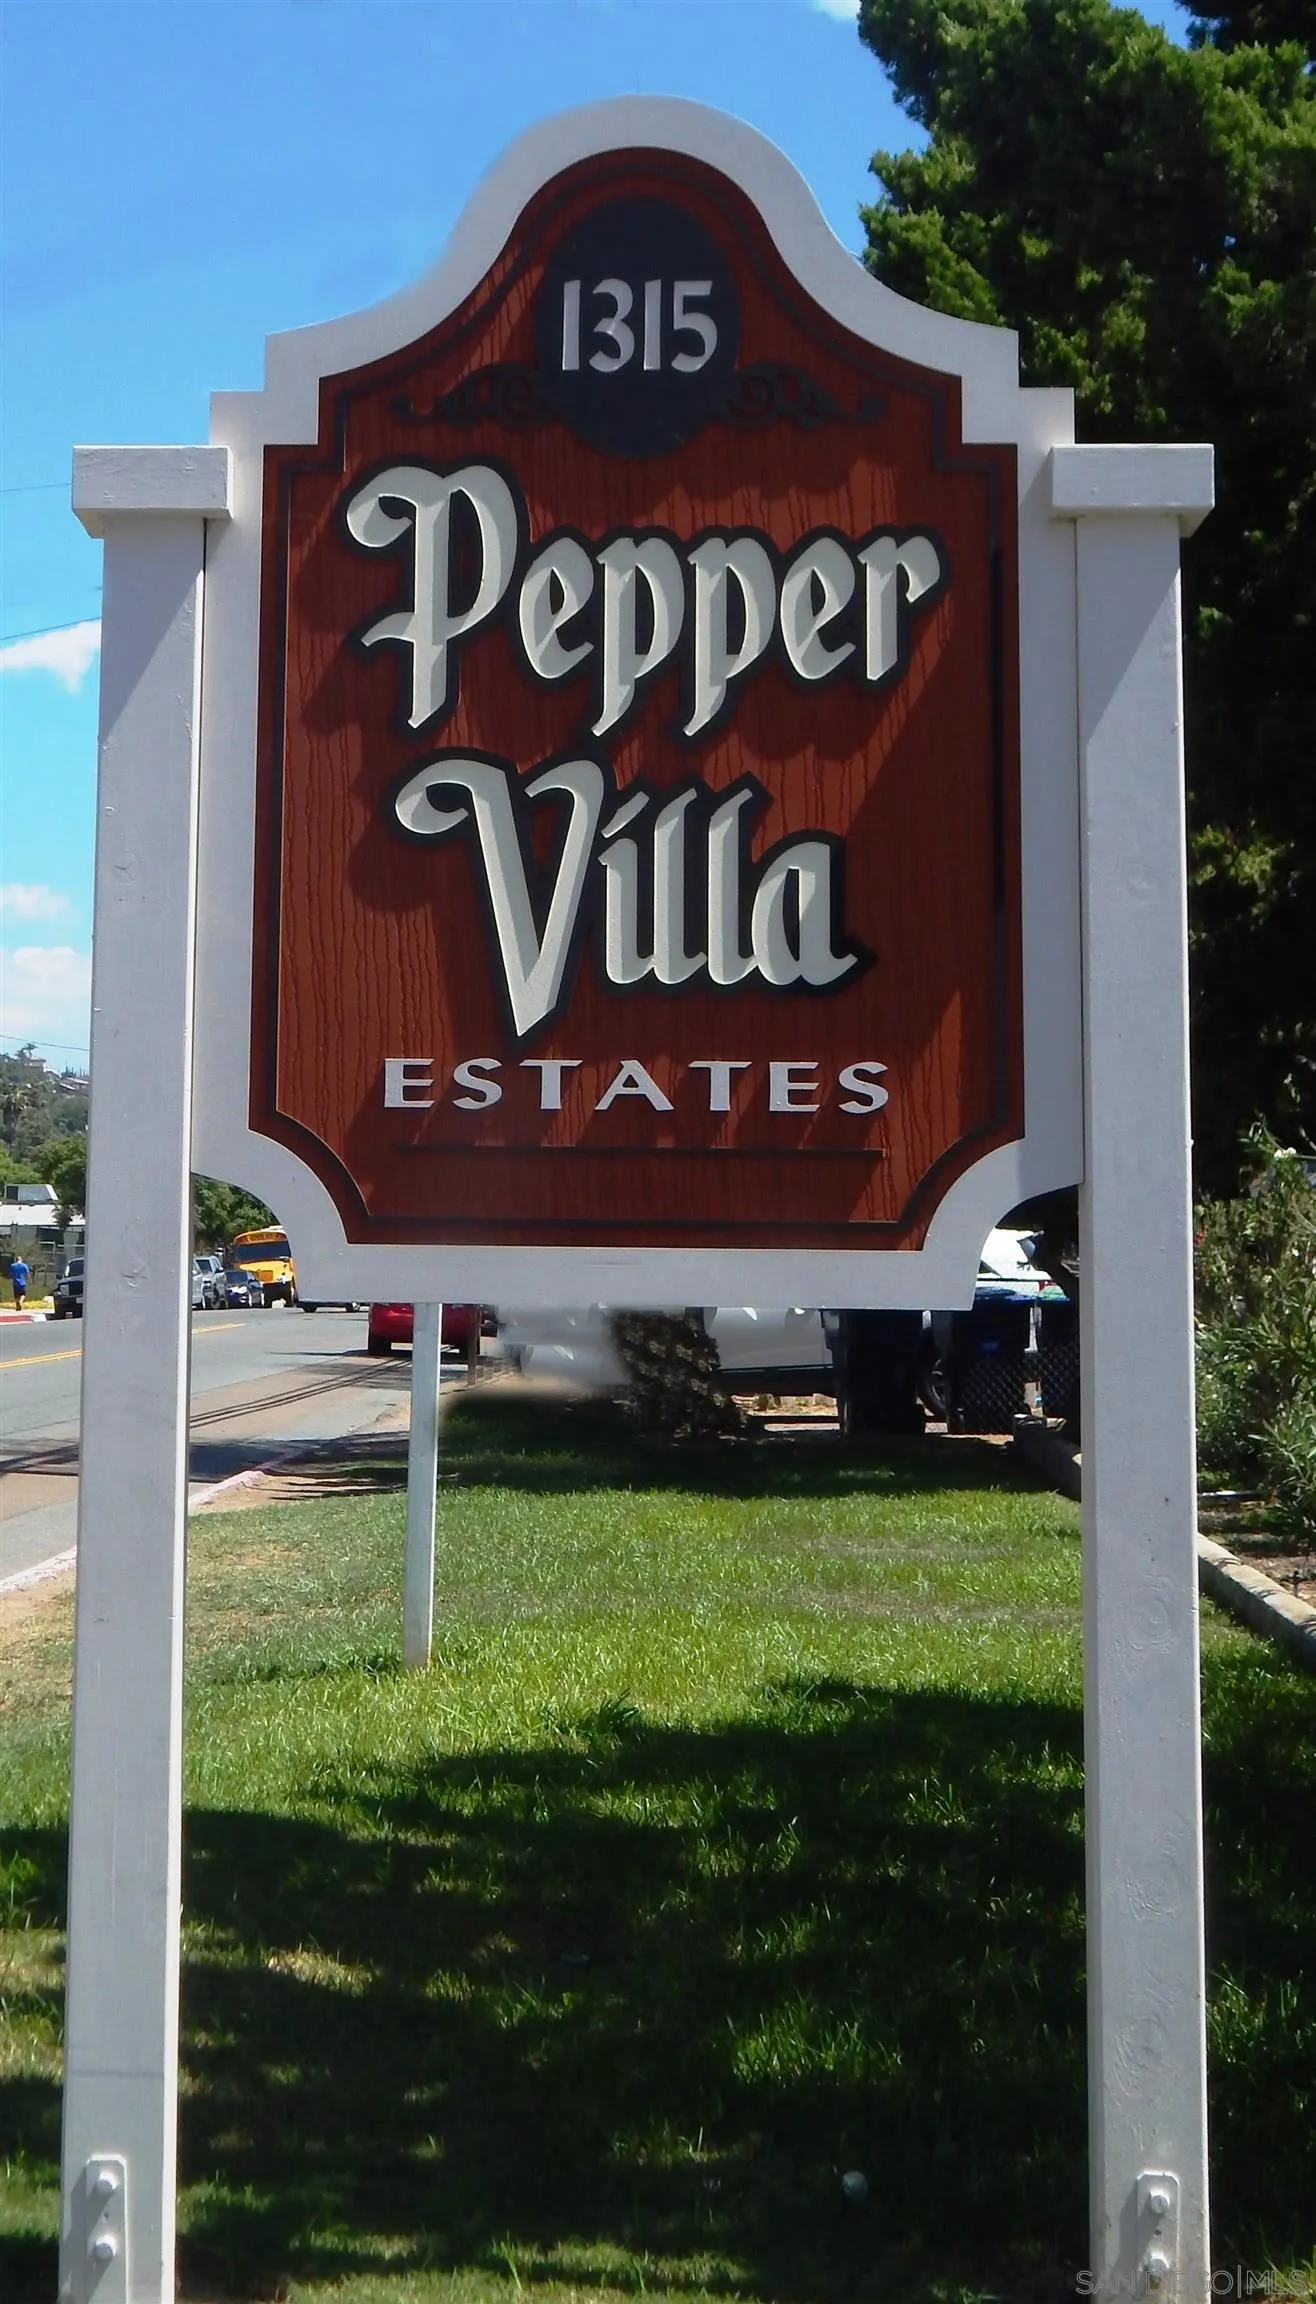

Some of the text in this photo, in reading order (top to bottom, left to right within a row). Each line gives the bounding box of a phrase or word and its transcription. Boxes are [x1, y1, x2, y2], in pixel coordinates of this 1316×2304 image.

[562, 278, 718, 373] 1315
[346, 465, 941, 736] Pepper
[394, 759, 859, 1036] Villa
[384, 1057, 890, 1113] ESTATES
